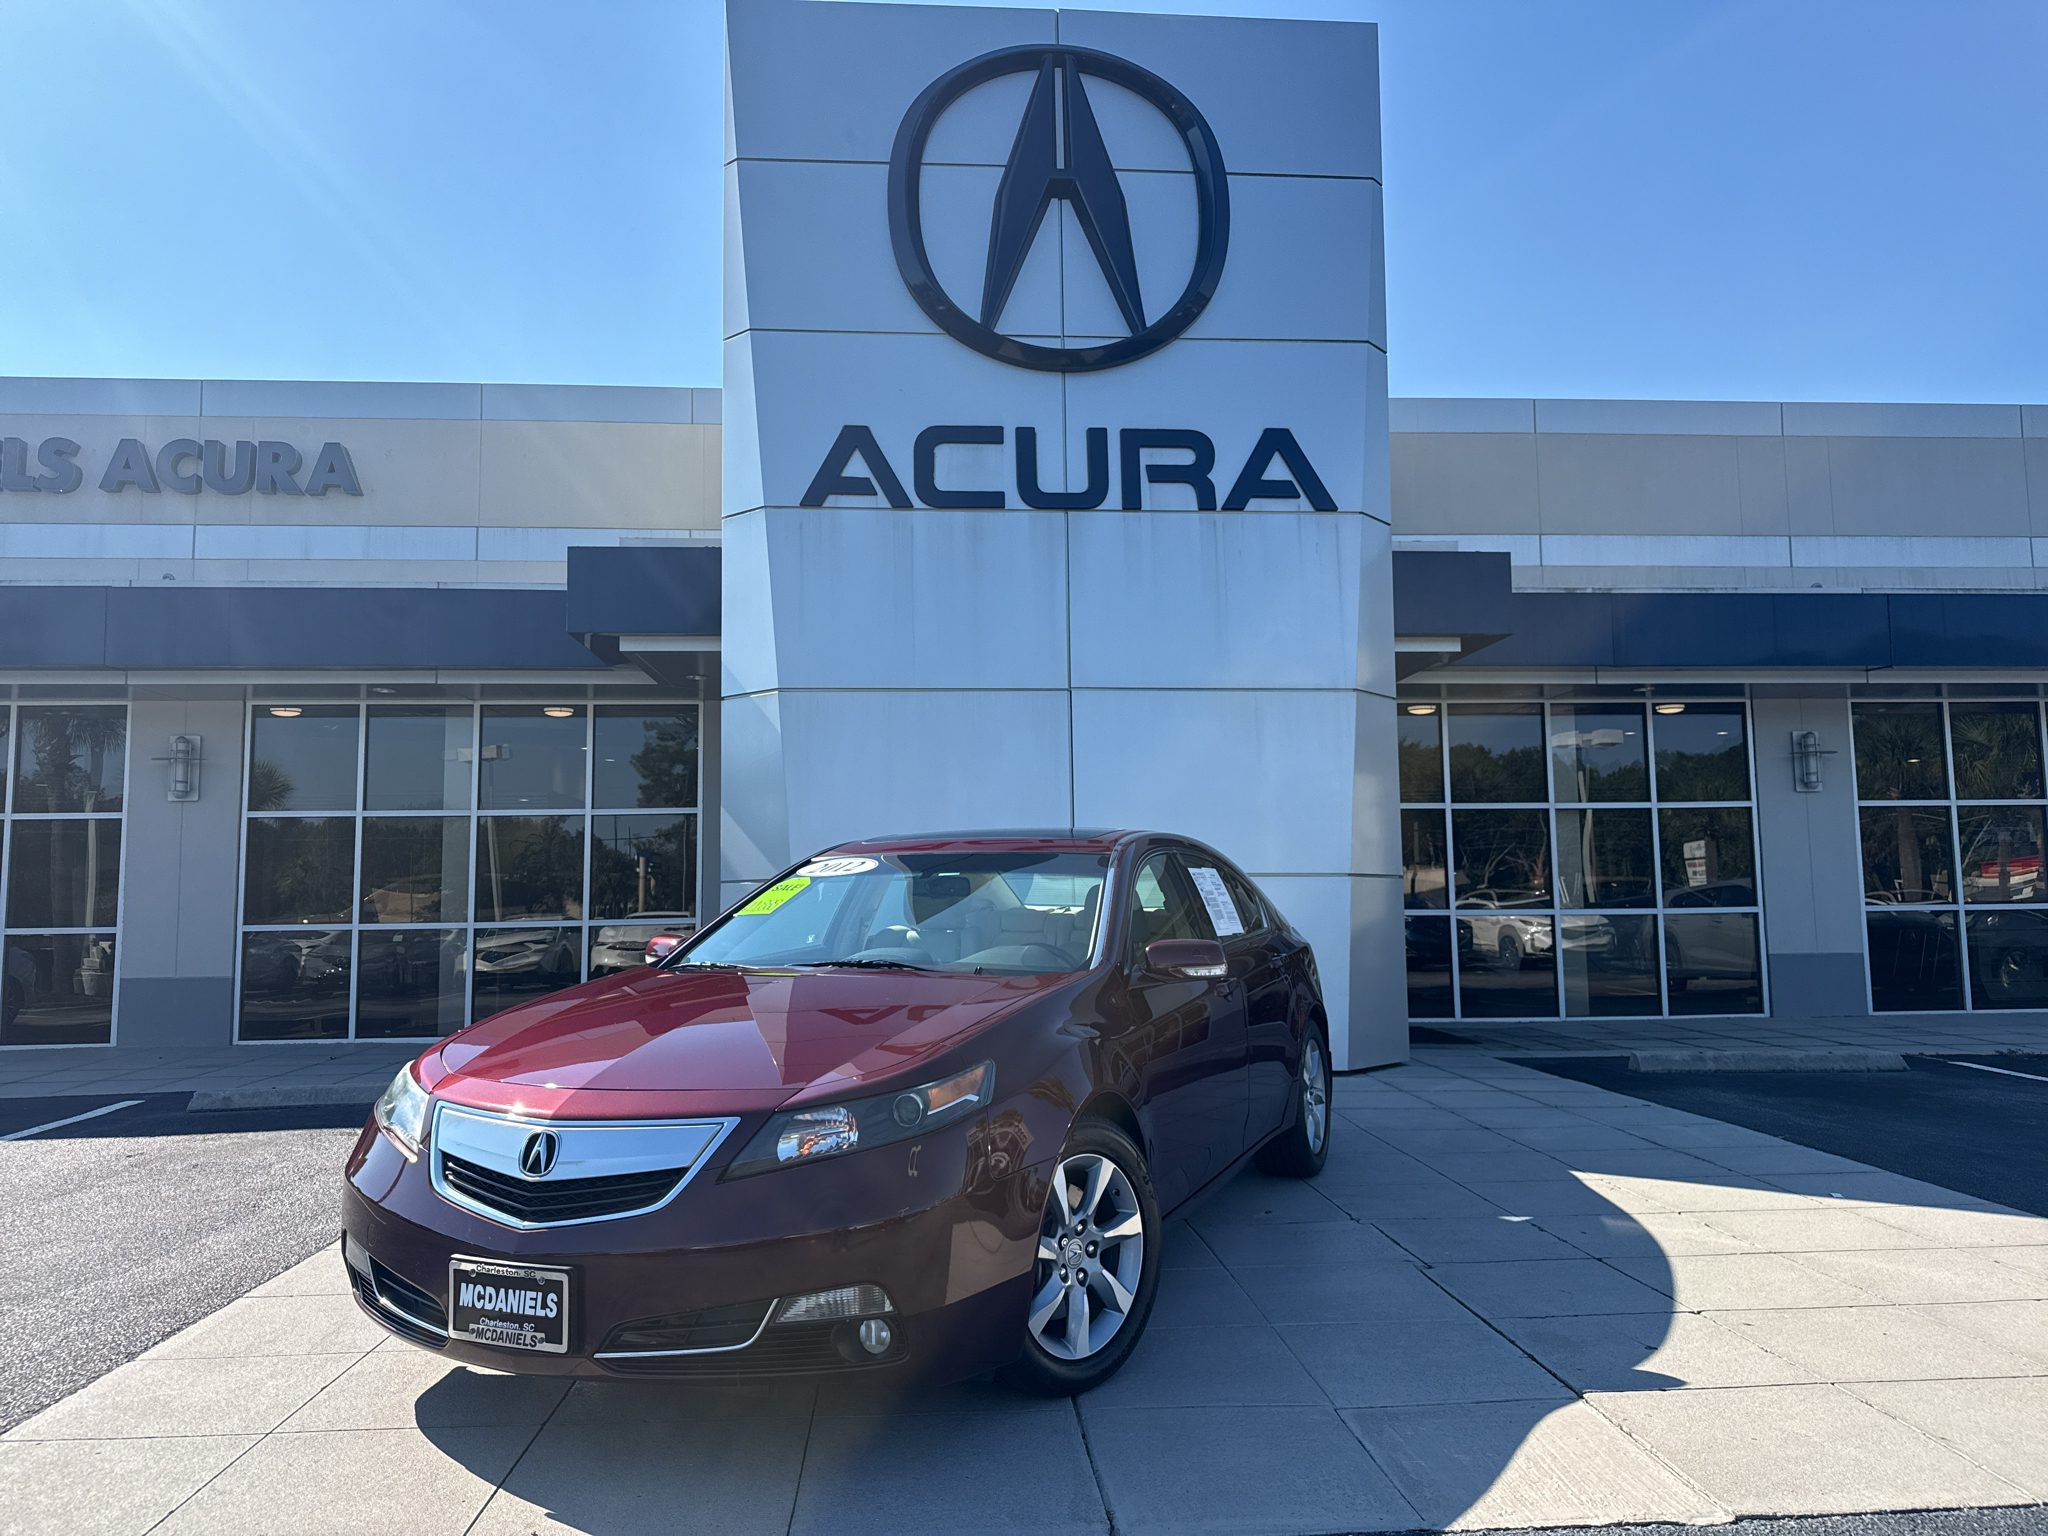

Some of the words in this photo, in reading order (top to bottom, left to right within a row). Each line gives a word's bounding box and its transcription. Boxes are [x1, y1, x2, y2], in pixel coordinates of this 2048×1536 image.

[0, 436, 83, 494] LS
[98, 438, 364, 496] ACURA
[799, 425, 1339, 511] ACURA
[806, 860, 867, 874] 2012
[523, 1270, 536, 1278] SC
[459, 1282, 558, 1318] MCDANIELS
[475, 1326, 538, 1348] MCDANIELS
[523, 1322, 535, 1332] SC
